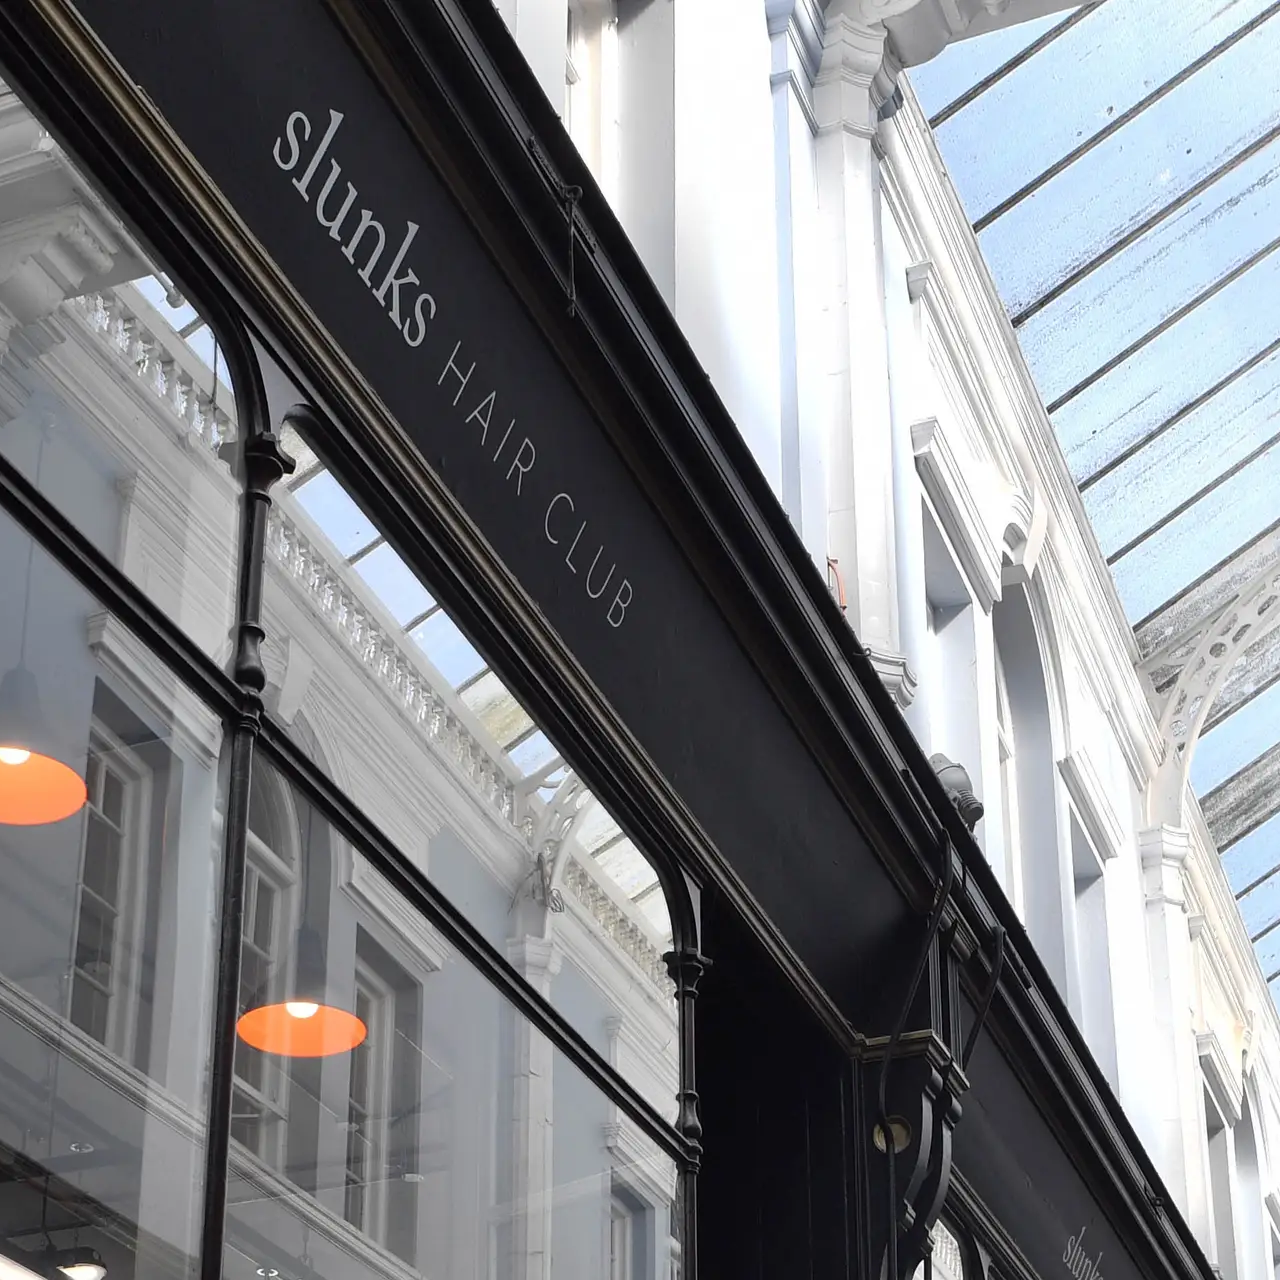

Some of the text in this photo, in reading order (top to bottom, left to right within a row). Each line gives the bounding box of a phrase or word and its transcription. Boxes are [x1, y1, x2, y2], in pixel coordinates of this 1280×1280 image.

[273, 108, 634, 628] slunks HAIR CLUB
